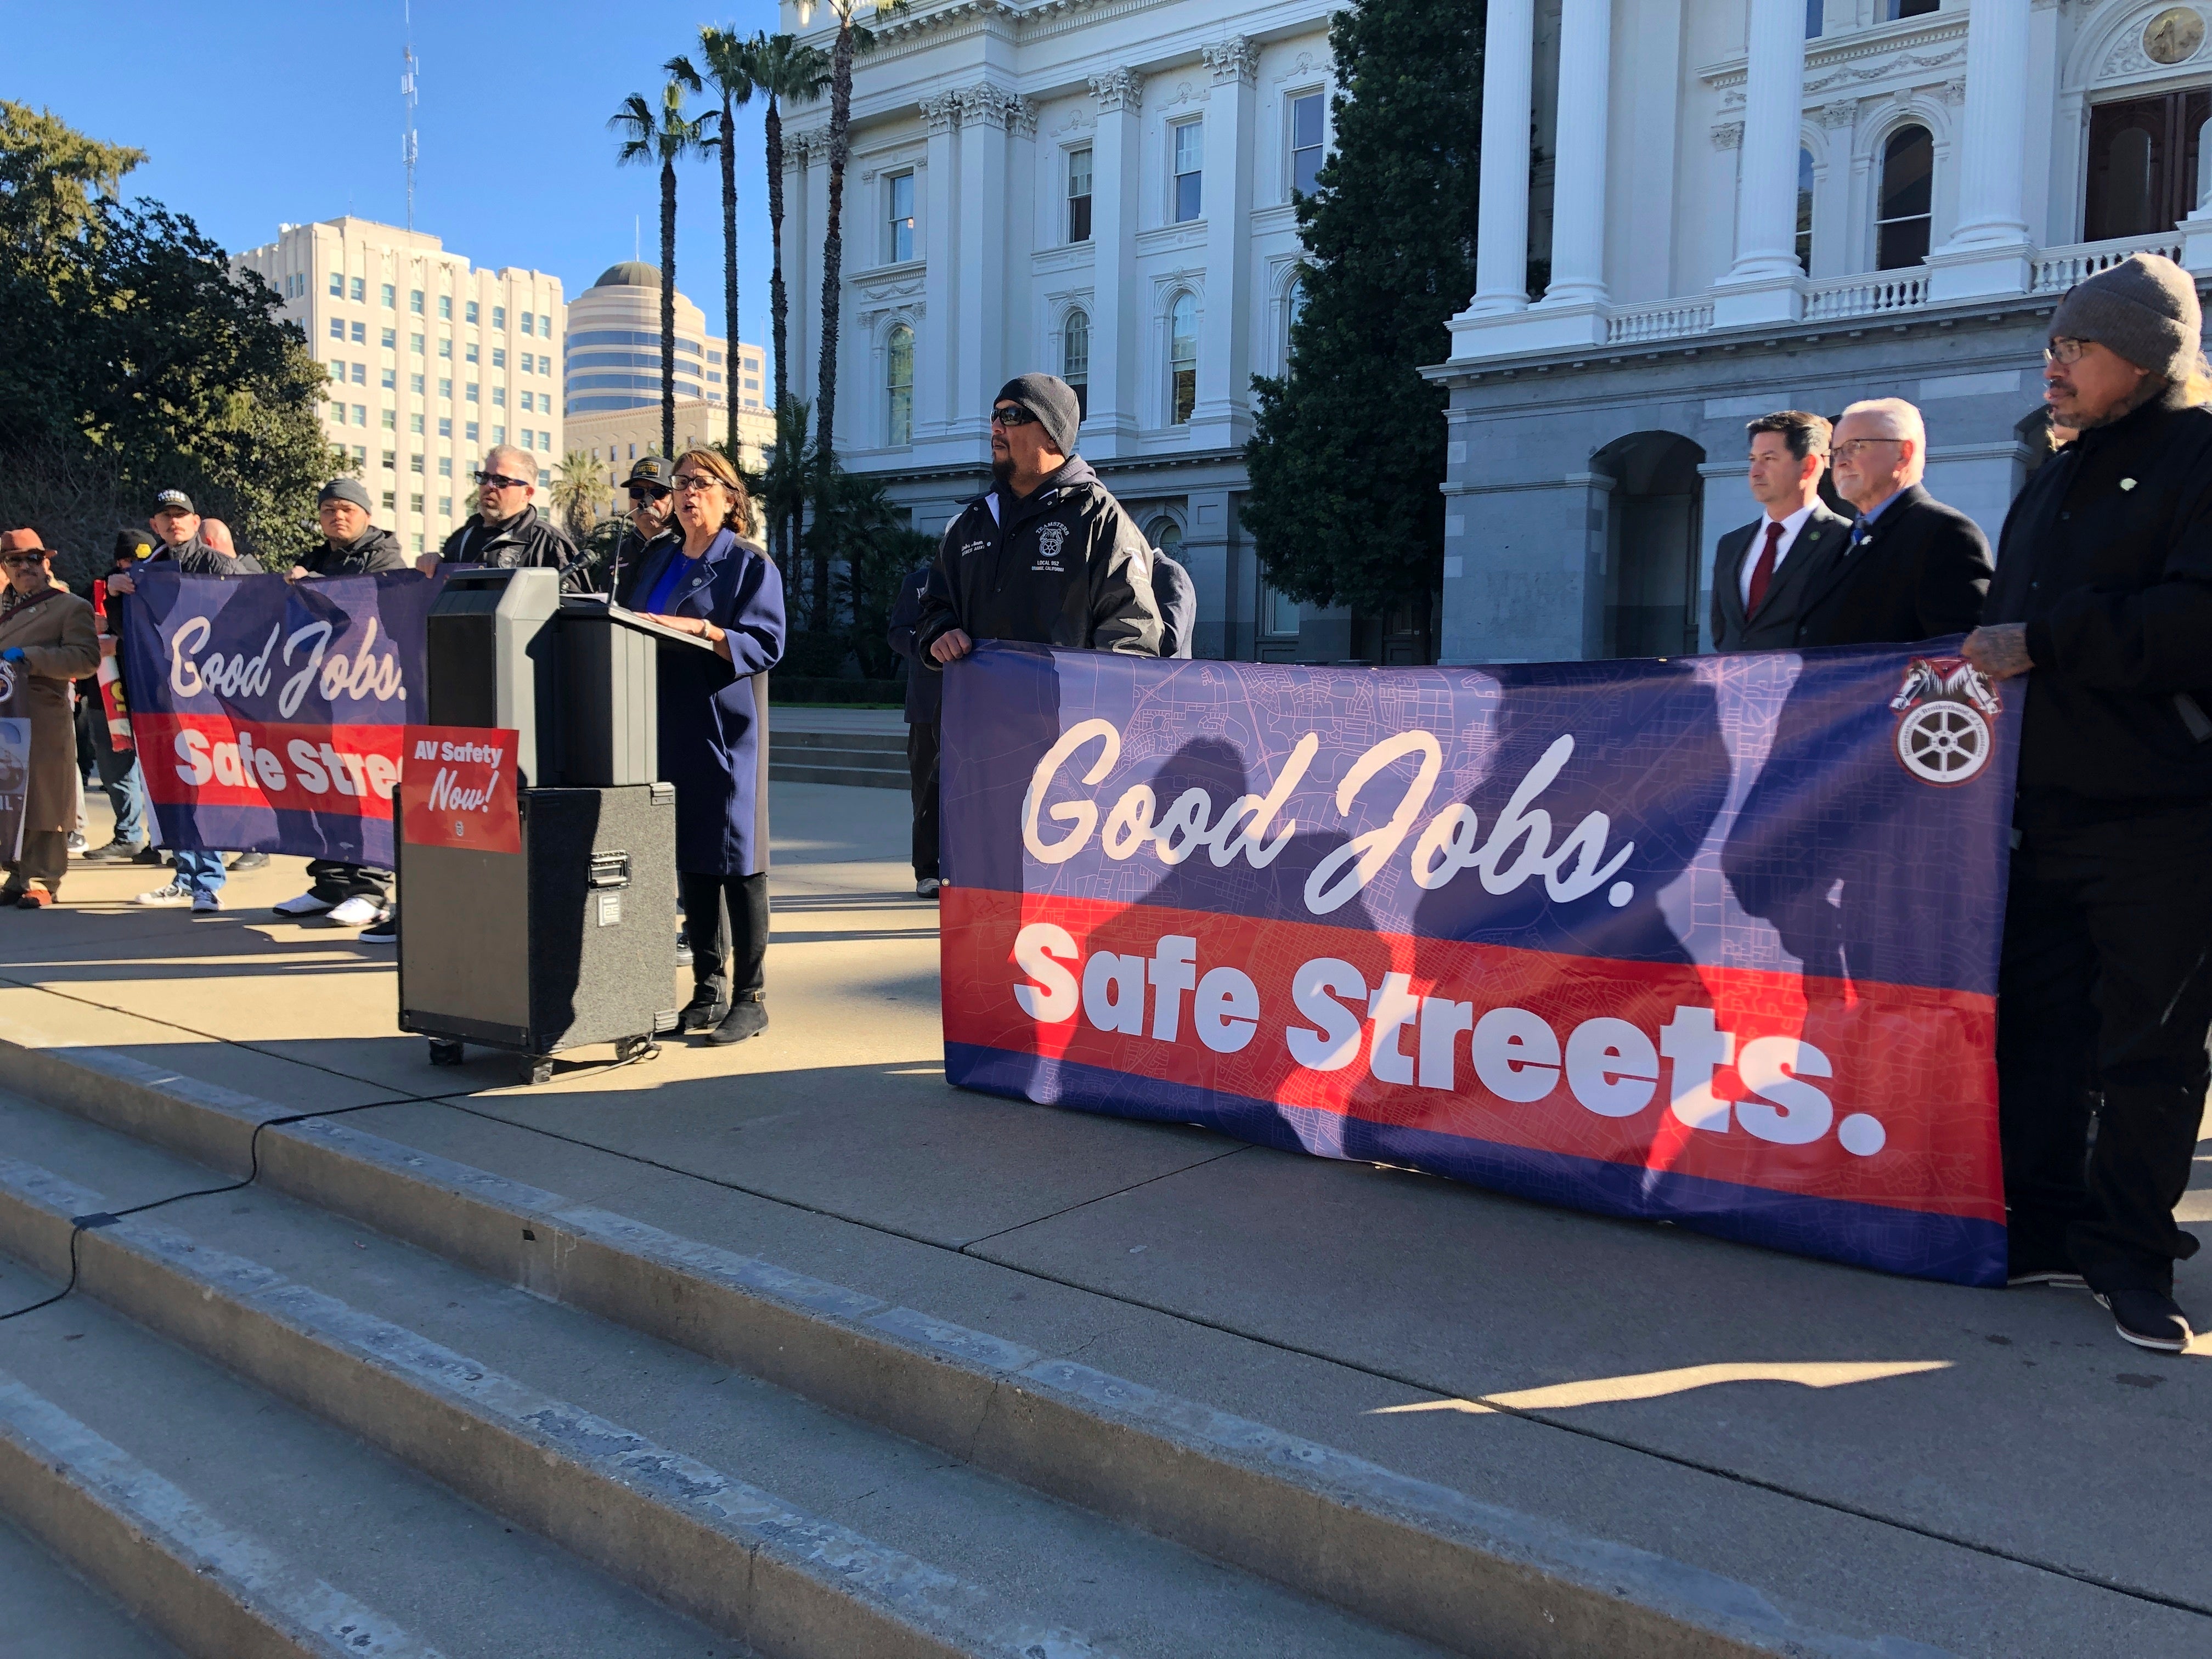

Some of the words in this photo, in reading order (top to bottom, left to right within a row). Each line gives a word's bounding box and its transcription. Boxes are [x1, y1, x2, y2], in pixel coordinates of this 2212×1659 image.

[1036, 522, 1069, 535] TEAMSTERS
[171, 616, 280, 697] Good
[278, 616, 407, 719] Jobs.
[174, 729, 287, 791] Safe
[287, 738, 403, 800] Stre
[414, 740, 438, 760] AV
[442, 742, 503, 769] Safety
[428, 767, 500, 813] Now!
[1022, 719, 1318, 869] Good
[1304, 730, 1635, 915] Jobs.
[1013, 923, 1260, 1053] Safe
[1285, 957, 1886, 1156] Streets.
